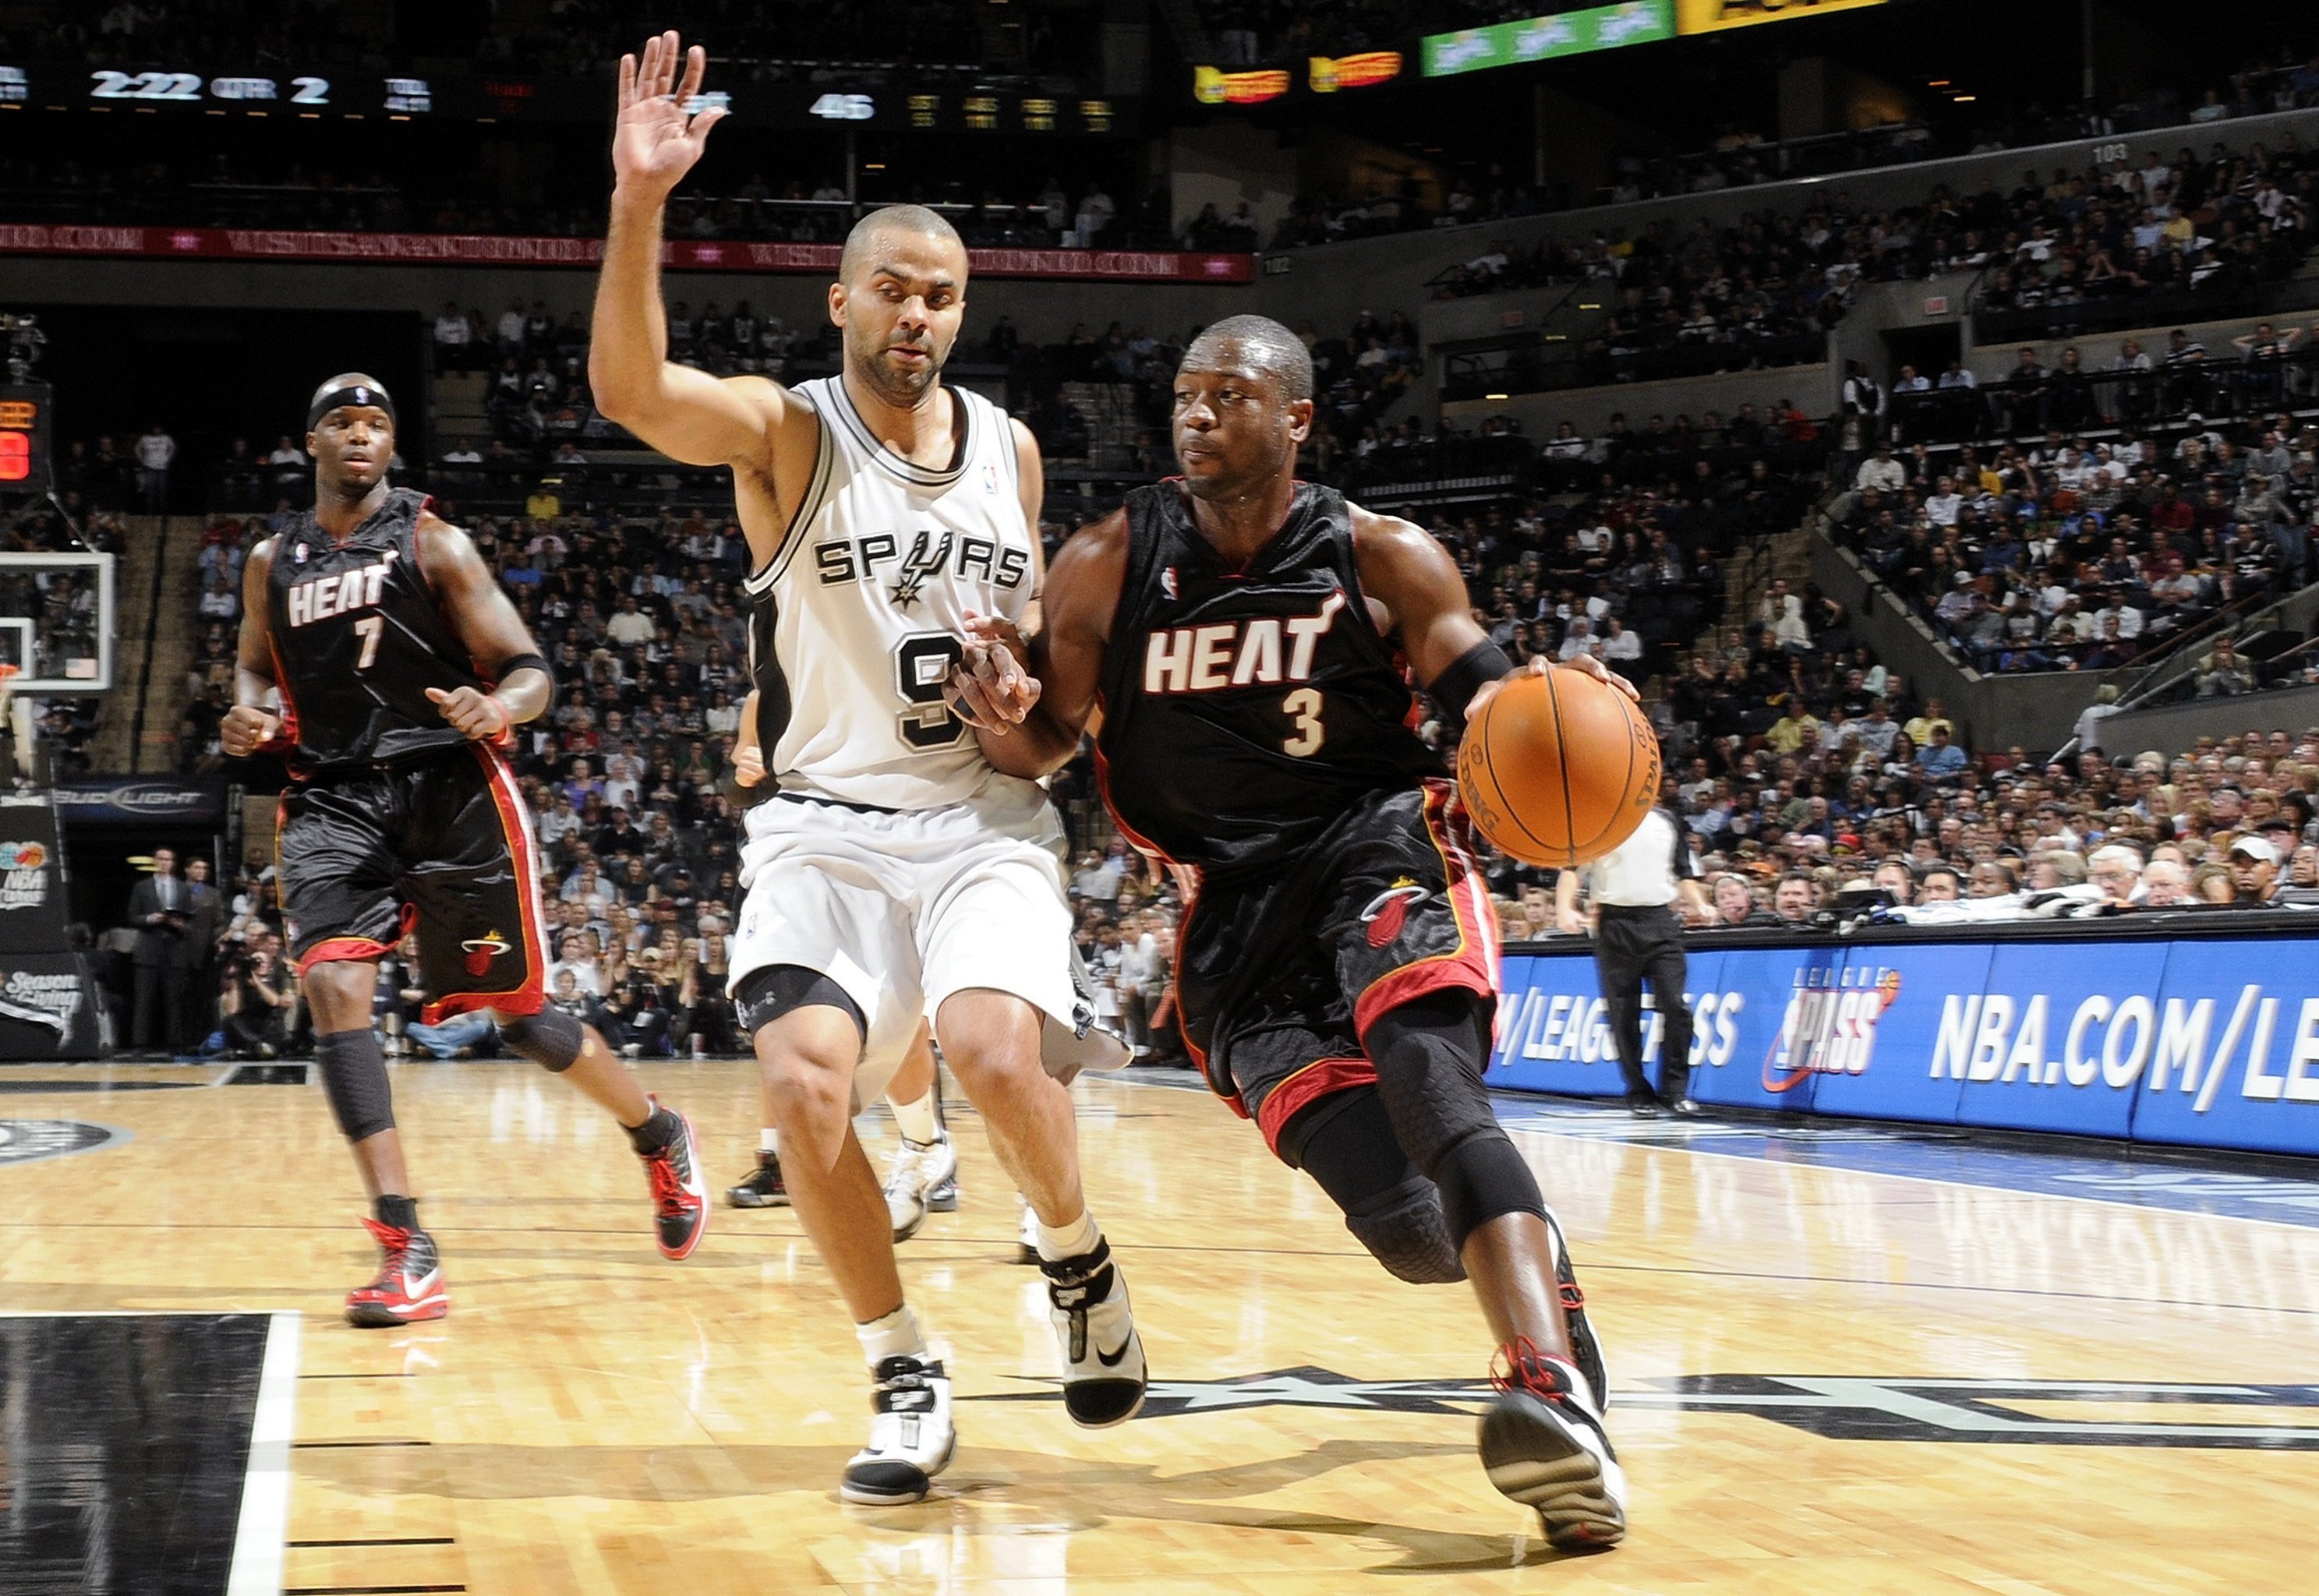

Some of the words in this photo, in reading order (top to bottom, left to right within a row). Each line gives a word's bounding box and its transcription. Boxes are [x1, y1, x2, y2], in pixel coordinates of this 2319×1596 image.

[291, 77, 330, 104] 2
[2092, 143, 2128, 164] 103
[288, 549, 401, 628] HEAT
[812, 530, 1030, 598] SPURS
[354, 614, 384, 669] 7
[1142, 587, 1347, 694] HEAT
[893, 630, 965, 754] 9
[1282, 687, 1325, 758] 3
[52, 789, 111, 805] BUD
[122, 792, 206, 805] LIGHT
[3, 870, 48, 890] NBA
[5, 971, 80, 994] Season
[1789, 990, 1880, 1075] PASS
